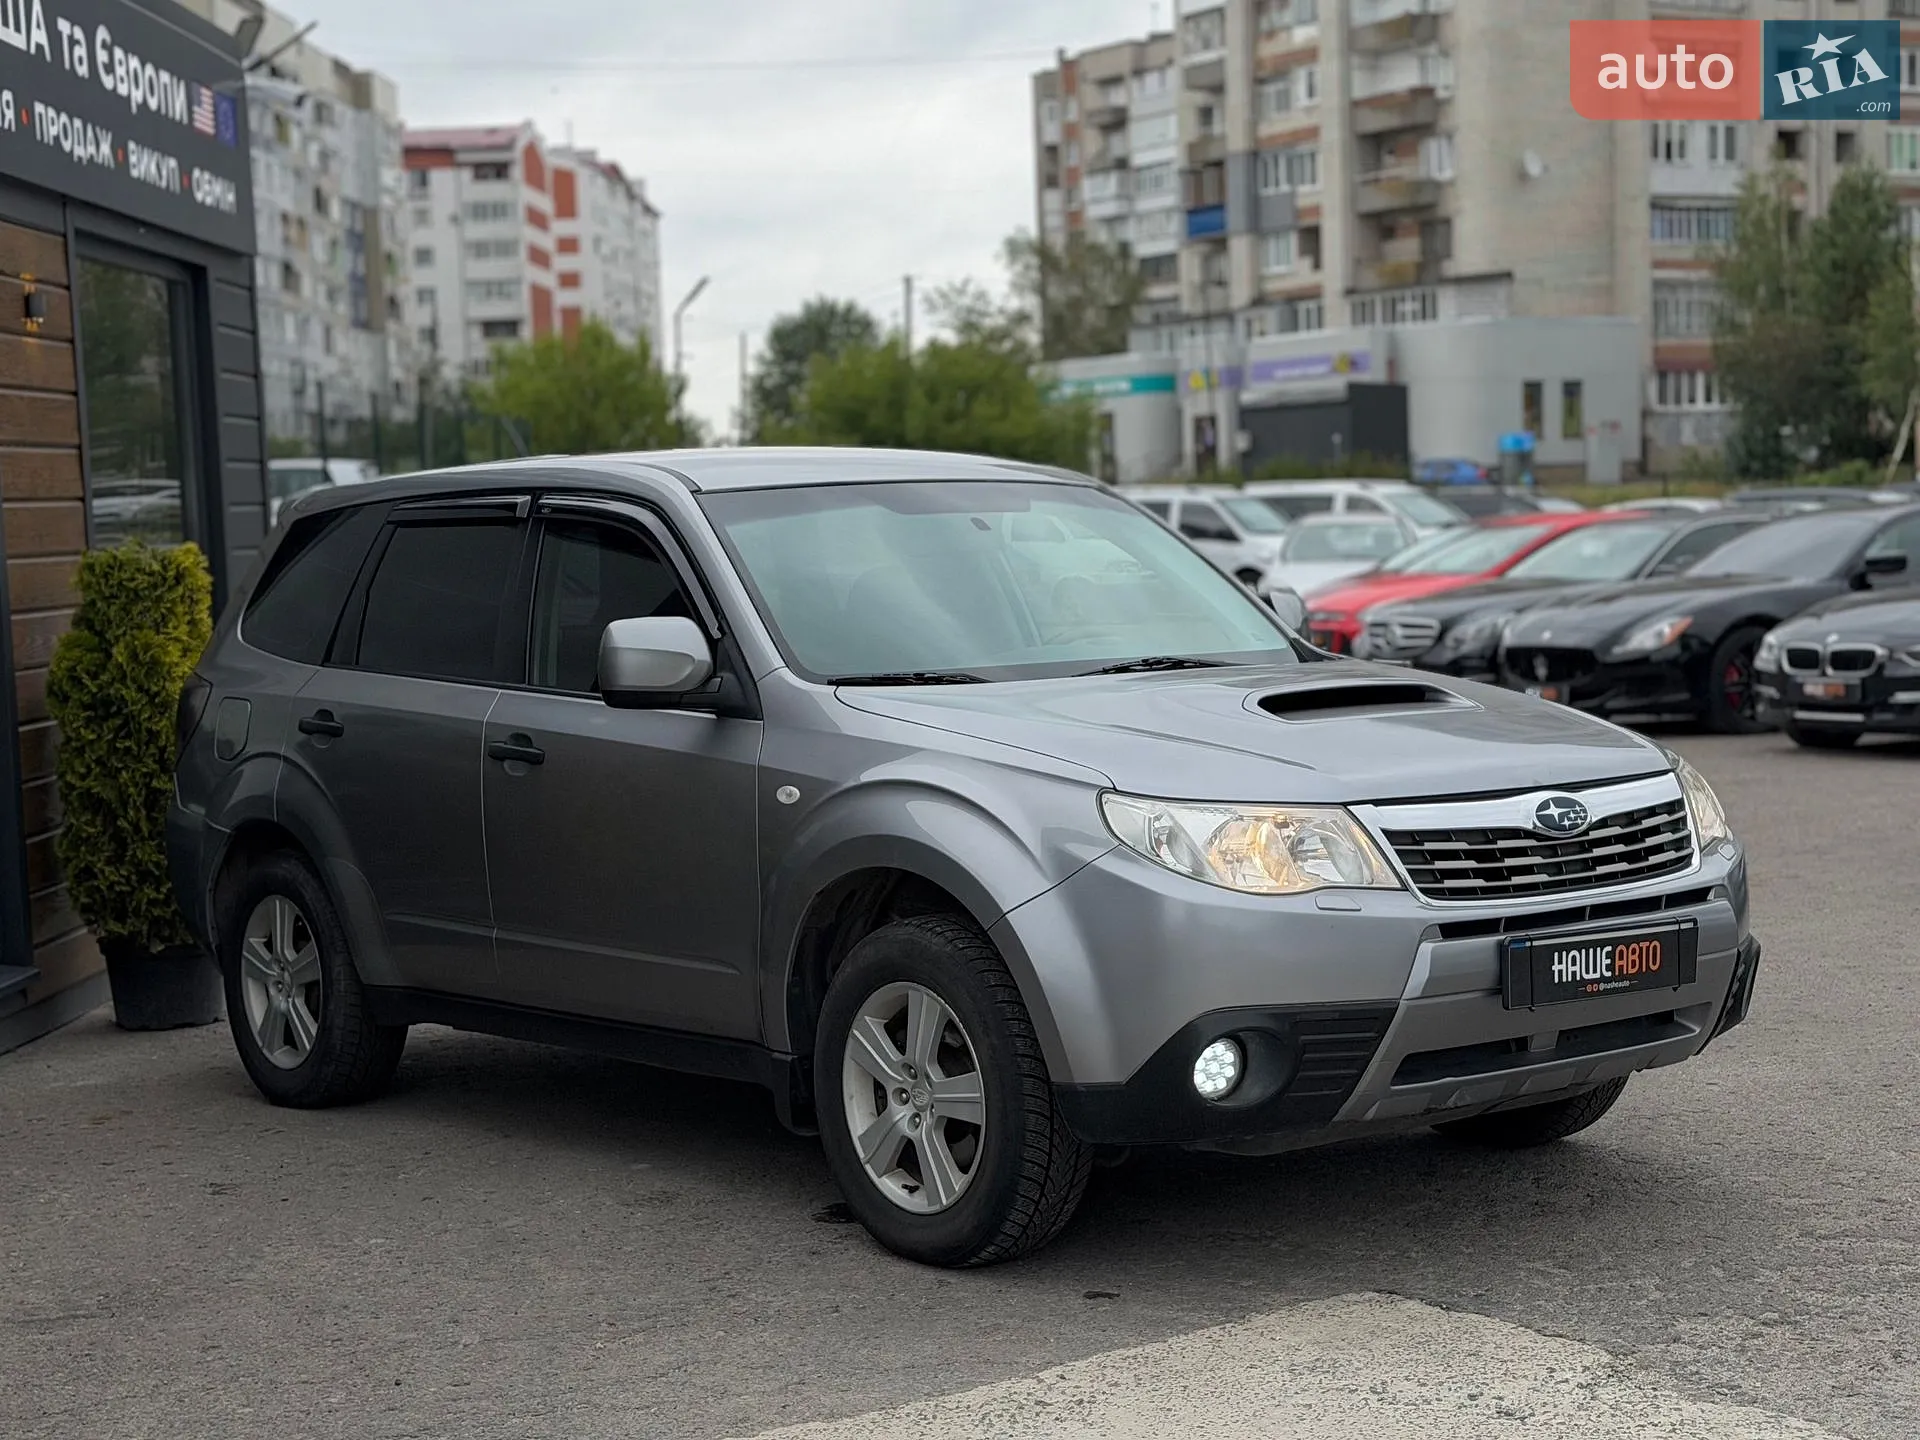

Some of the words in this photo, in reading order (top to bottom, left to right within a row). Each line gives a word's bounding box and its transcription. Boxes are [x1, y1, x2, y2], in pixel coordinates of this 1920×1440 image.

[57, 17, 89, 79] та
[95, 24, 188, 125] Європи
[0, 89, 16, 132] Я
[33, 101, 115, 169] ПРОДАЖ
[127, 139, 181, 194] ВИКУП
[1551, 945, 1612, 983] НАШЕ
[1614, 940, 1661, 976] АВТО
